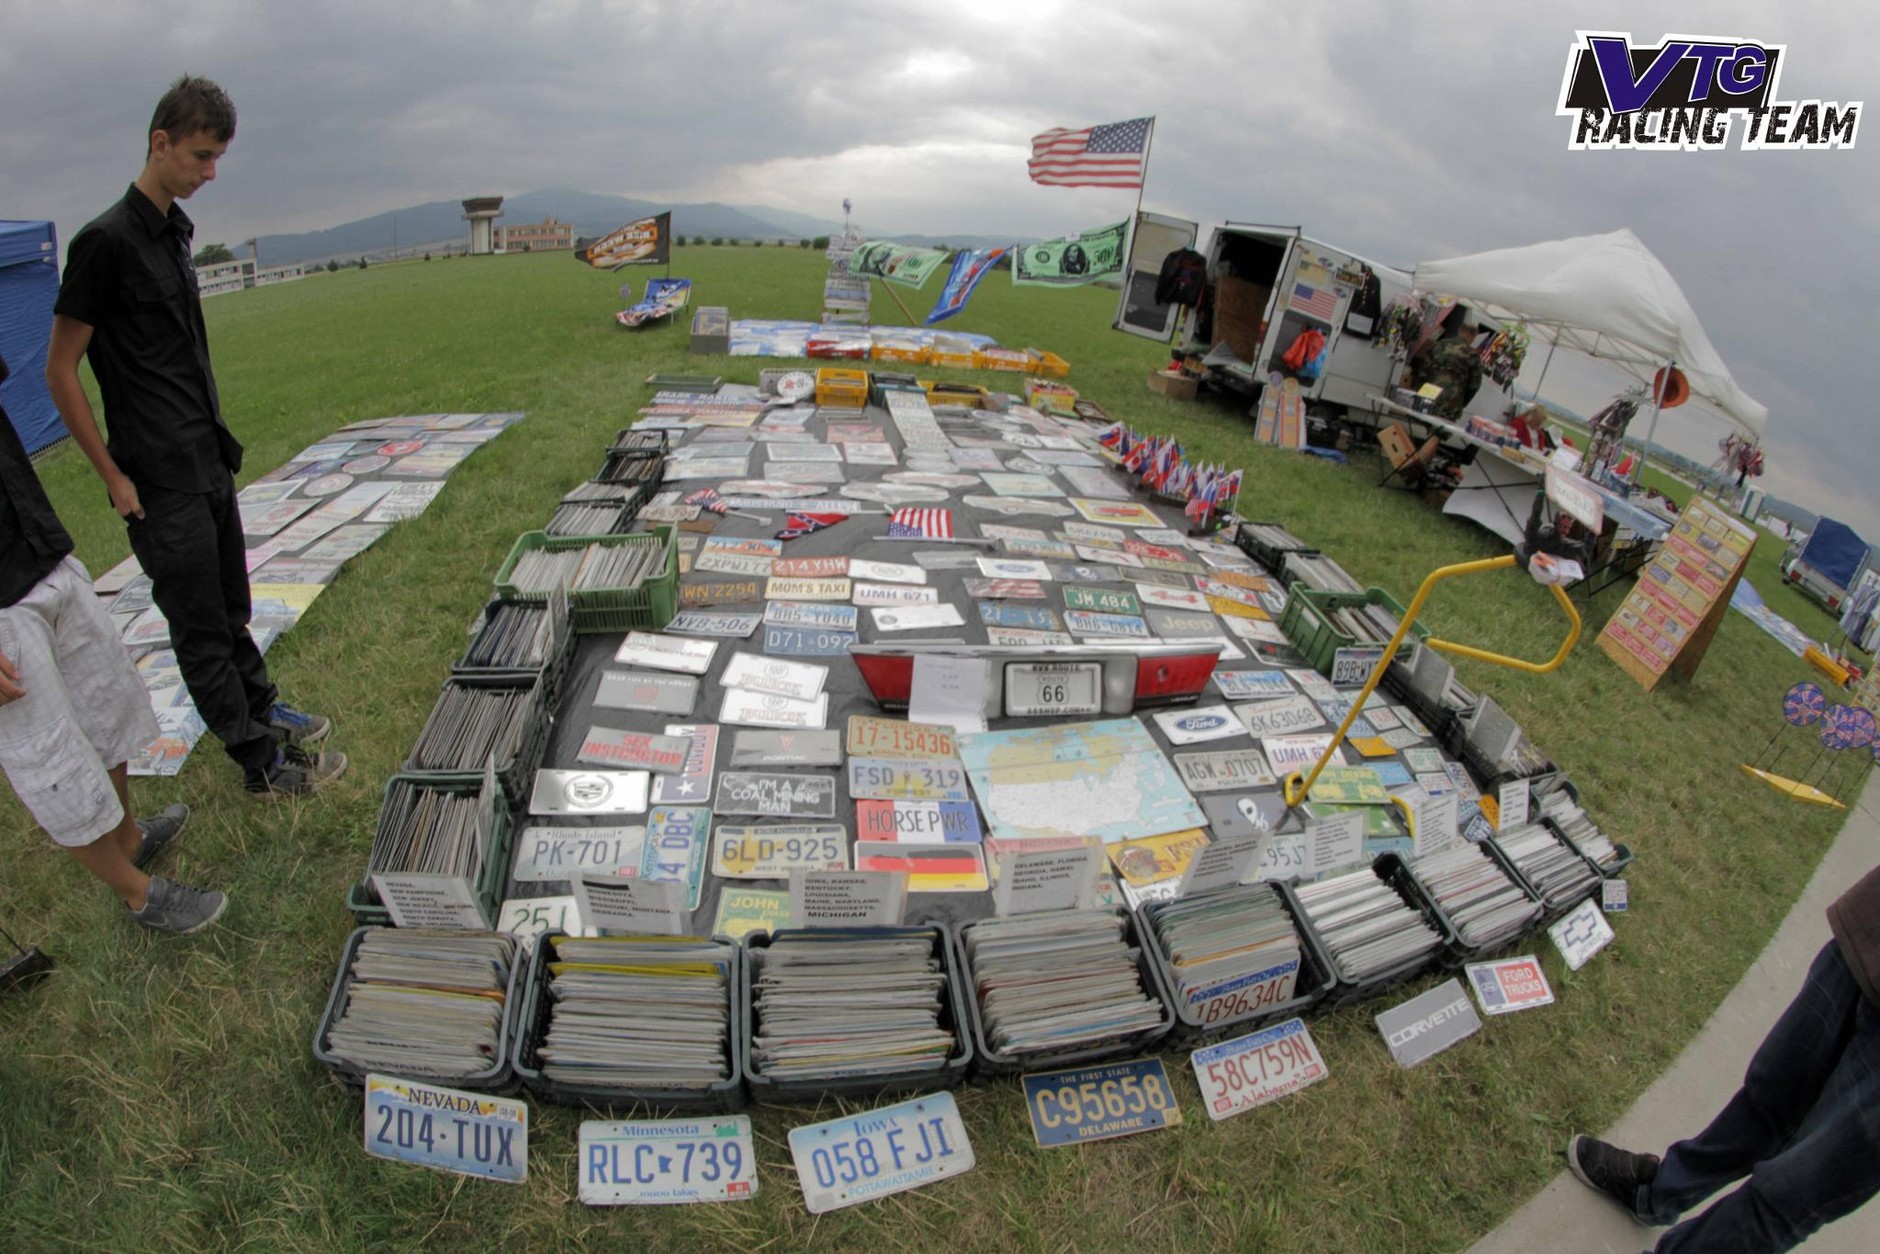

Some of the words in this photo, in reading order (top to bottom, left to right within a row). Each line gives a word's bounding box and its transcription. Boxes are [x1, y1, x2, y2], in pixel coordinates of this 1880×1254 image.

[775, 559, 847, 571] 214YHW
[770, 583, 814, 594] MOM'S
[818, 584, 847, 594] TAXI
[1100, 596, 1131, 609] 484
[716, 618, 751, 632] 506
[1161, 615, 1215, 633] Jeep
[768, 630, 802, 644] D71
[1042, 684, 1065, 704] 66
[1184, 717, 1219, 731] Ford
[623, 732, 654, 746] SEX
[856, 725, 952, 756] 17-15436
[583, 741, 683, 764] INSTRUCTOR
[762, 754, 808, 762] PONTIAC
[1271, 748, 1309, 764] UMH
[759, 779, 777, 791] I'M
[781, 780, 793, 792] A
[853, 766, 895, 786] FSD
[920, 768, 960, 789] 319
[731, 788, 769, 801] COAL
[773, 789, 821, 804] MINING
[758, 800, 791, 813] MAN
[867, 809, 925, 833] HORSE
[928, 809, 970, 833] PWR
[661, 811, 695, 850] DBC
[532, 839, 622, 867] PK-701
[722, 837, 839, 862] 6LD-925
[730, 896, 780, 911] JOHN
[1502, 966, 1535, 984] FORD
[1504, 978, 1543, 997] TRUCKS
[1387, 997, 1472, 1049] CORVETTE
[1207, 1033, 1314, 1098] 58C759N
[1060, 1075, 1077, 1084] THE
[1080, 1072, 1103, 1082] FIRST
[1106, 1066, 1131, 1078] STATE
[407, 1086, 483, 1116] NEVADA
[1036, 1073, 1168, 1129] C95658
[622, 1124, 700, 1137] Minnesota
[1078, 1116, 1144, 1137] DELAWARE
[588, 1143, 655, 1184] RLC
[676, 1141, 743, 1183] 739
[672, 1187, 699, 1199] lakes
